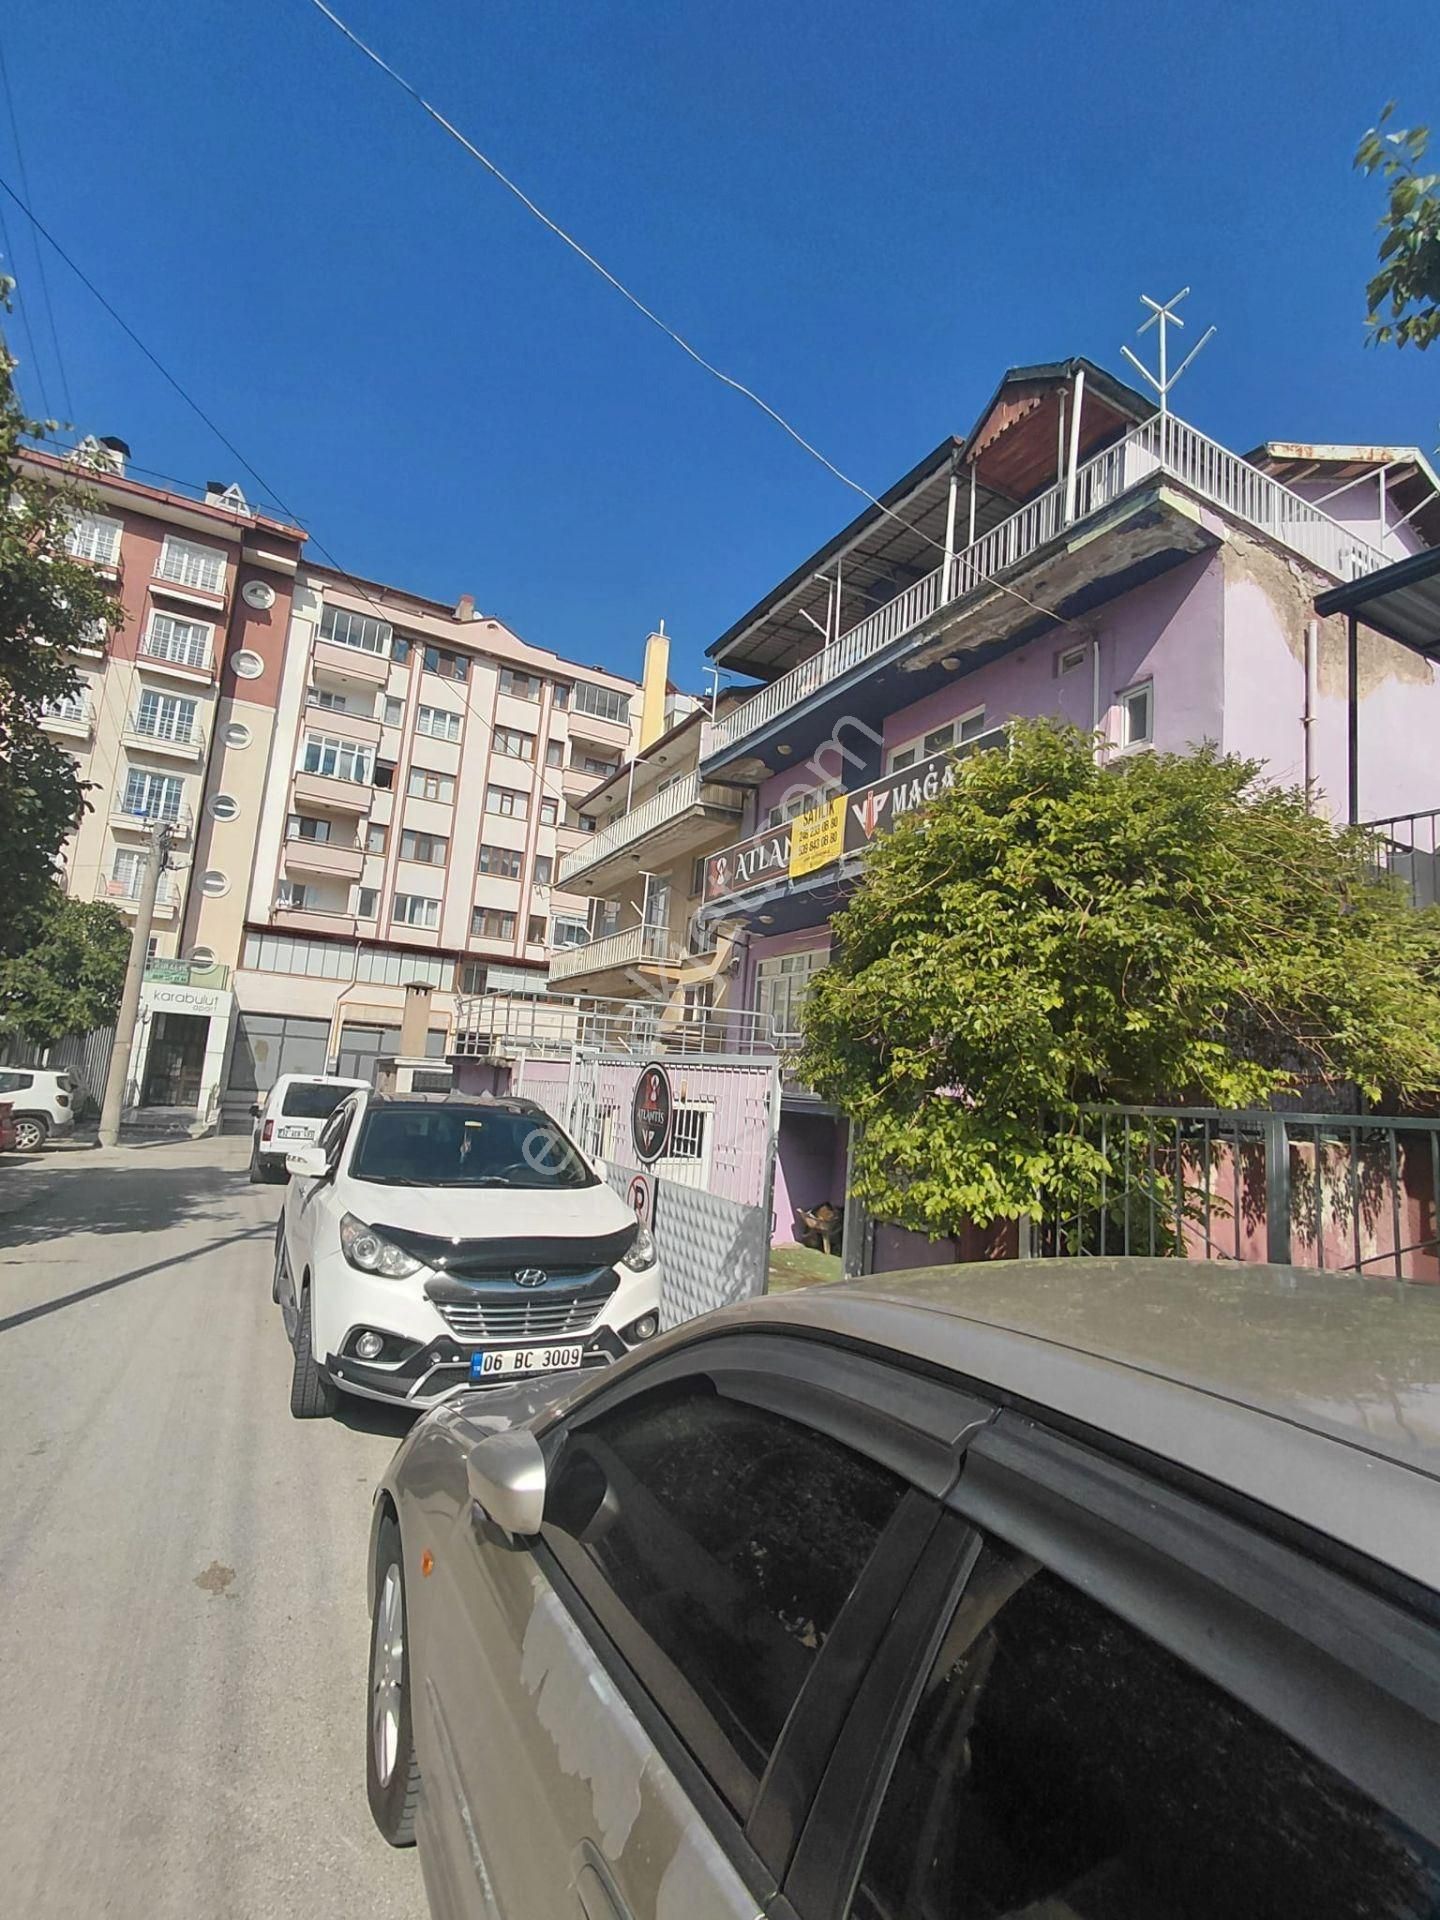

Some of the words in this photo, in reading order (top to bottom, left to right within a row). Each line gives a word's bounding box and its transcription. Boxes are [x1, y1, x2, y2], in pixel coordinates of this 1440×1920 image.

[154, 990, 218, 1006] karabulut
[484, 1354, 503, 1372] 06
[514, 1351, 534, 1369] BC
[542, 1349, 579, 1367] 3009
